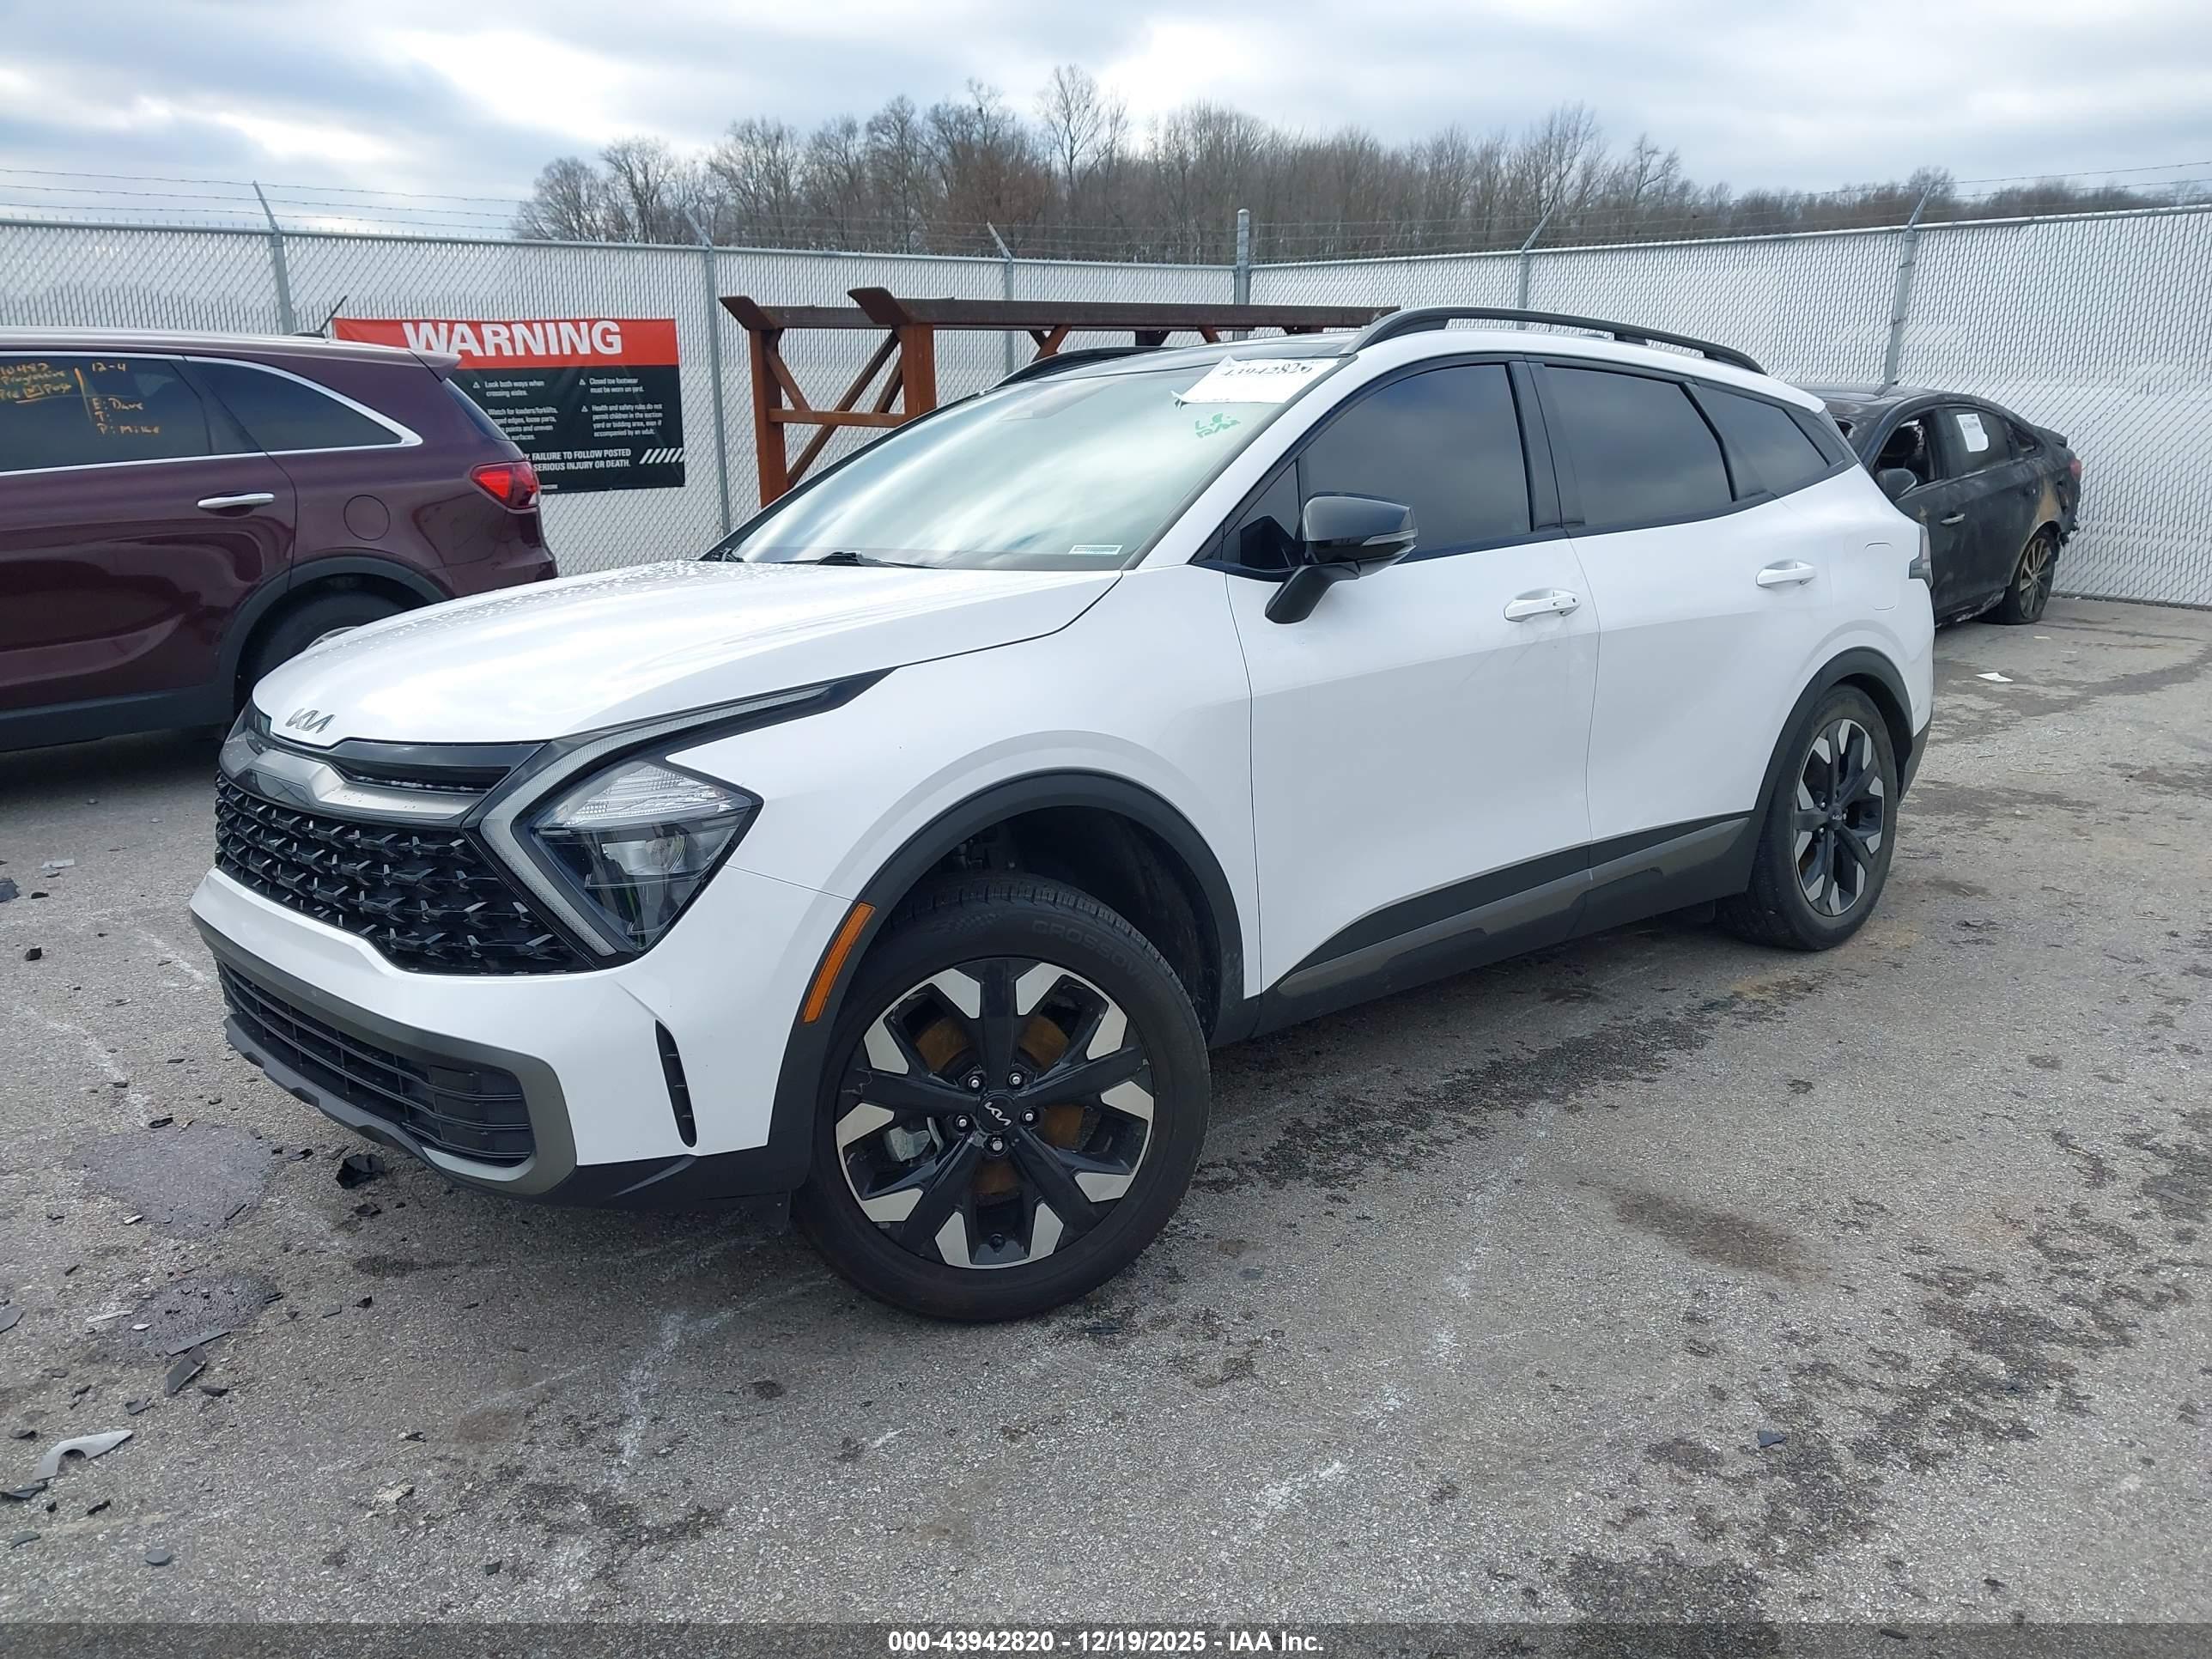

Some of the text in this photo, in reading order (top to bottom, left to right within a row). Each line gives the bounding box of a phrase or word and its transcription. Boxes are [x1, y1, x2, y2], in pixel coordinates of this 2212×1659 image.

[402, 320, 623, 356] WARNING
[592, 422, 605, 430] yard
[532, 452, 562, 461] FAILURE
[562, 451, 573, 459] TO
[574, 450, 603, 459] FOLLOW
[604, 448, 631, 458] POSTED
[533, 462, 565, 471] SERIOUS
[566, 461, 593, 470] INJURY
[605, 459, 631, 468] DEATH.
